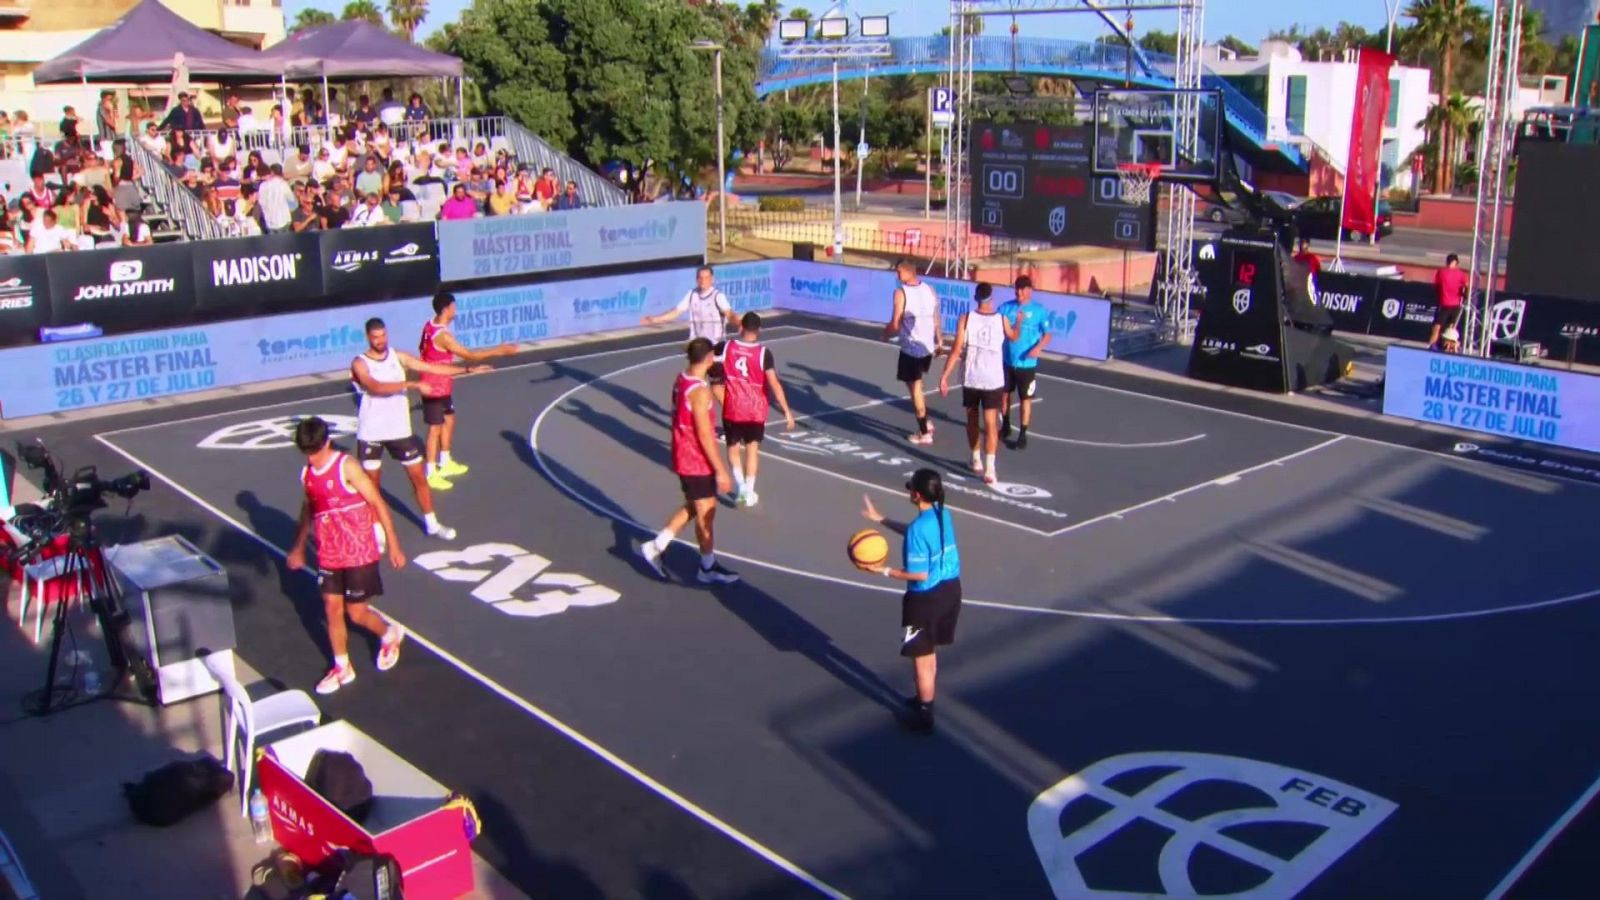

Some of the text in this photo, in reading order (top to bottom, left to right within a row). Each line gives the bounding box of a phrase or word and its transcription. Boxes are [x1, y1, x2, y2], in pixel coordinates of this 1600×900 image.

[937, 90, 947, 110] P
[989, 170, 1017, 192] 00
[1122, 223, 1132, 237] 0
[472, 231, 573, 256] MÁSTER FINAL
[212, 253, 297, 287] MADISON
[334, 250, 379, 265] ARMAS
[504, 256, 520, 272] 27
[1238, 262, 1257, 285] 12
[122, 278, 175, 296] SMITH
[454, 303, 549, 332] MÁSTER FINAL
[256, 325, 365, 356] tenerife
[474, 331, 482, 345] Y
[484, 329, 498, 344] 27
[501, 327, 516, 342] DE
[517, 322, 548, 341] JULIO
[1202, 339, 1236, 351] ARMAS
[54, 347, 218, 388] MÁSTER FINAL
[735, 356, 749, 377] 4
[1430, 358, 1557, 392] CLASIFICATORIO PARA
[56, 369, 215, 408] 26 Y 27 DE JULIO
[1425, 374, 1562, 419] MÁSTER FINAL
[1423, 400, 1557, 441] 26 Y 27 DE JULIO
[1280, 777, 1367, 818] FEB
[272, 795, 315, 837] ARMAS
